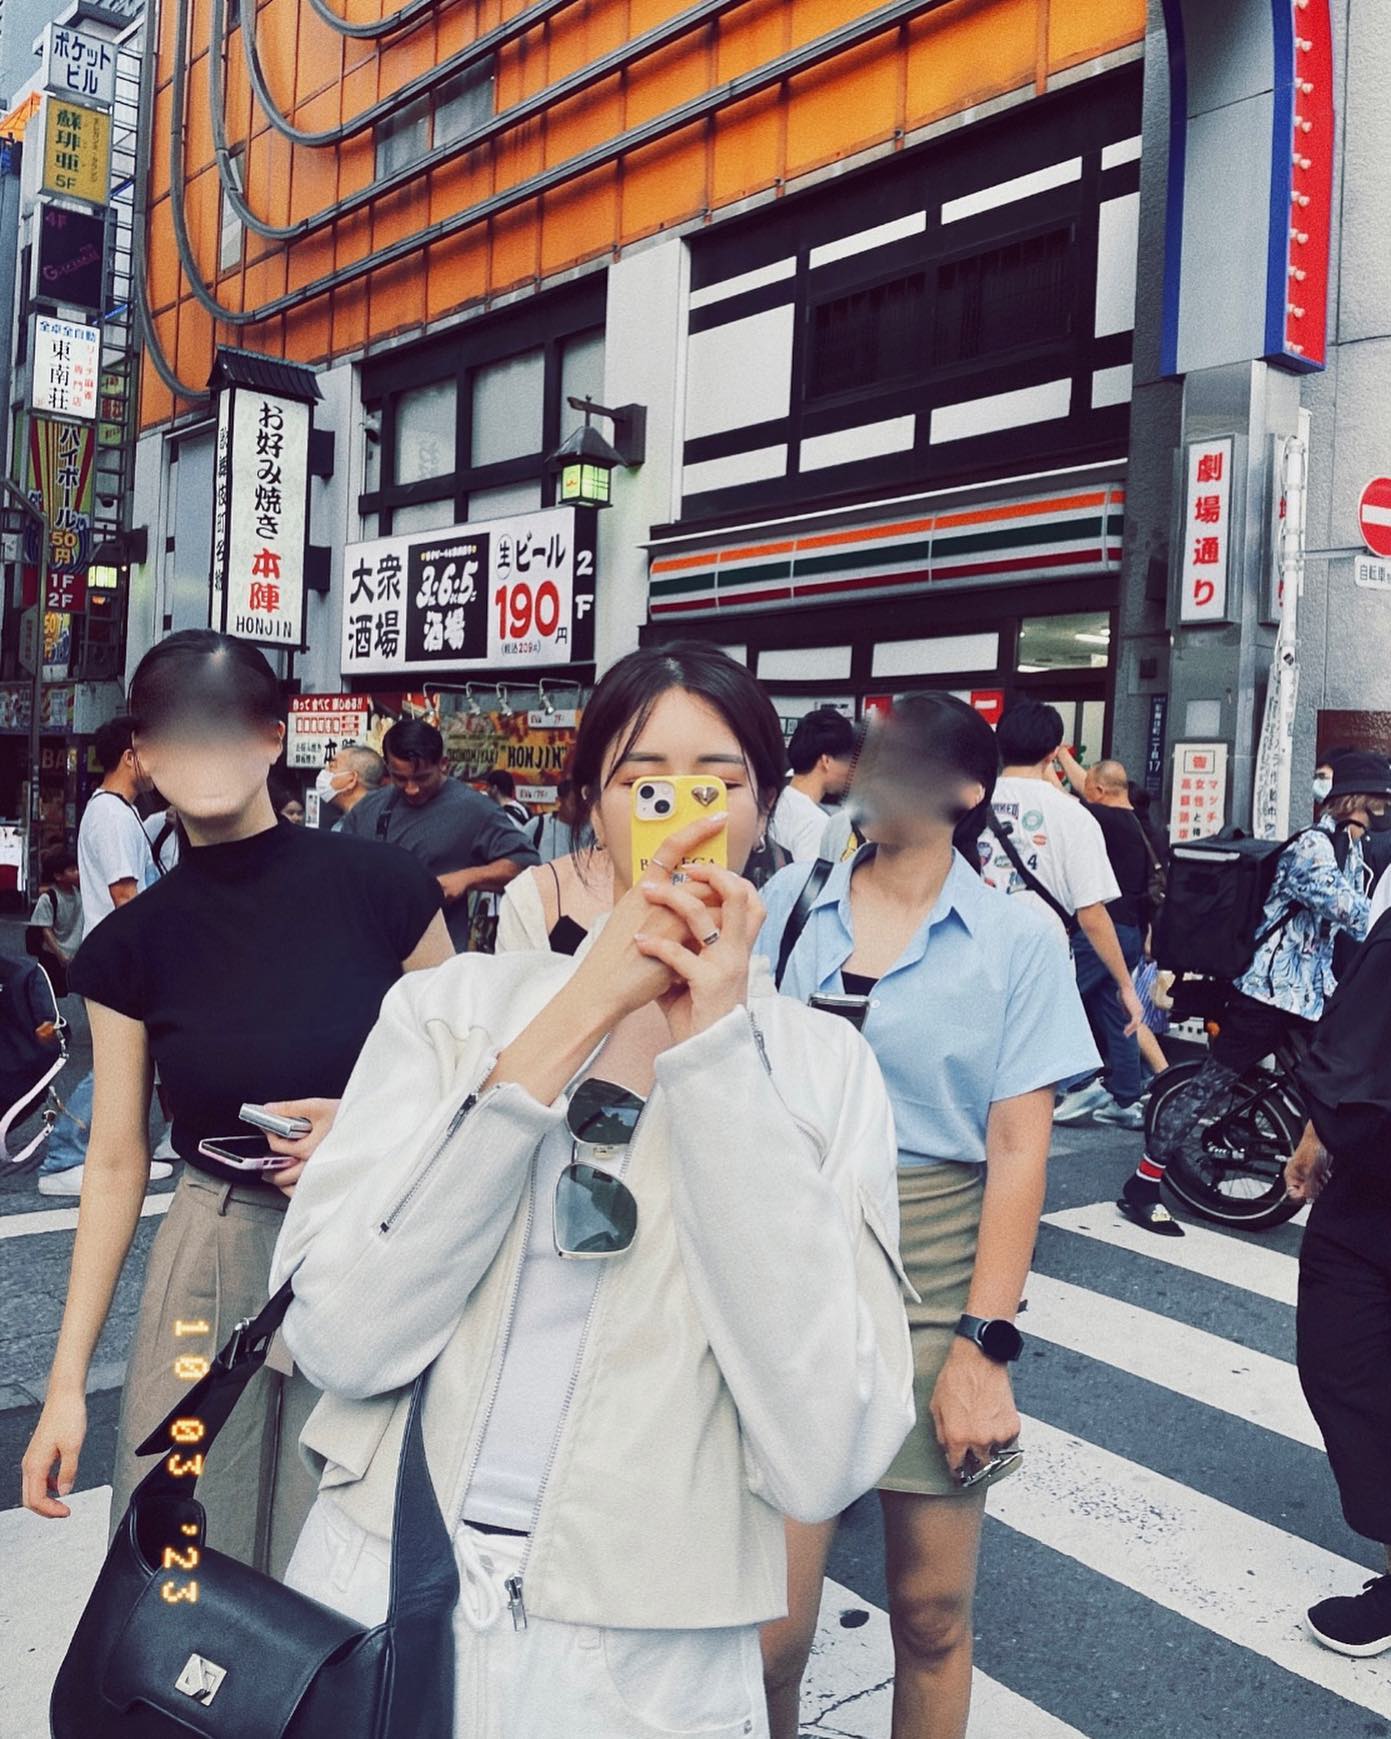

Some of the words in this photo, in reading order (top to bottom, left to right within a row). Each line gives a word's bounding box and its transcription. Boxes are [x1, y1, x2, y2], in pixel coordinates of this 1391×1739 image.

[53, 31, 111, 70] ポケット
[66, 68, 98, 94] ビル
[56, 174, 77, 189] 5F
[49, 339, 71, 411] 東南荘
[56, 426, 81, 528] ハイボール
[253, 401, 284, 540] お好み焼き
[1193, 453, 1223, 607] 劇場通り
[47, 593, 73, 608] 2F
[51, 573, 75, 588] 1F
[249, 548, 282, 613] 本陣
[350, 554, 402, 604] 大衆
[576, 550, 594, 620] 2F
[236, 615, 292, 639] HONJIN
[349, 609, 400, 660] 酒場
